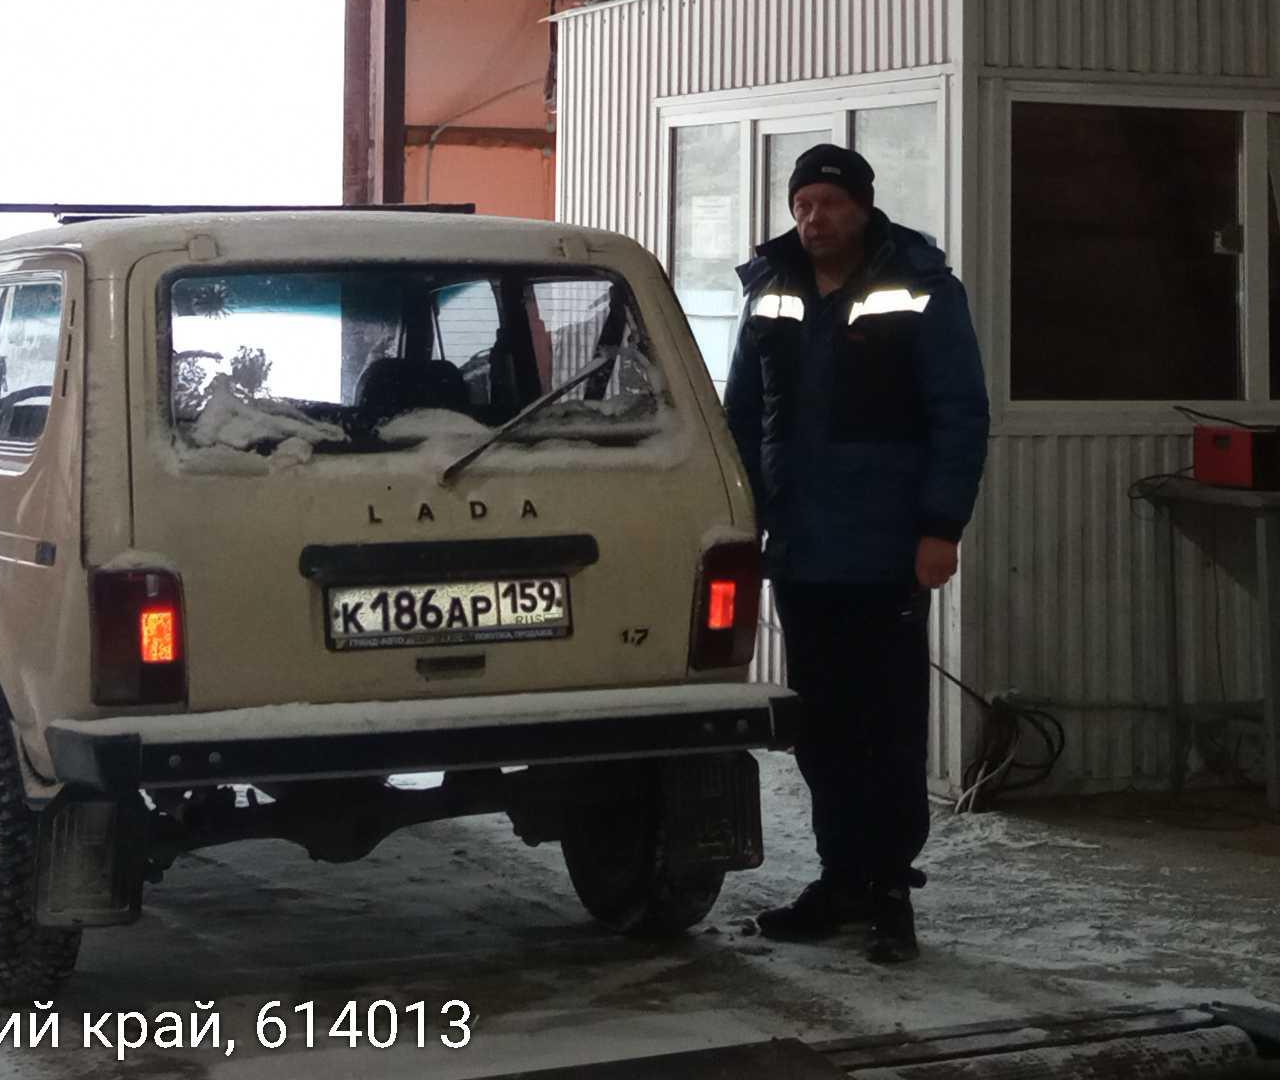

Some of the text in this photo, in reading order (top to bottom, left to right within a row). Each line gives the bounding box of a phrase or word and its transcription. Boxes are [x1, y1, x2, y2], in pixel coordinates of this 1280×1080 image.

[368, 499, 538, 524] LADA
[341, 580, 556, 633] К186АР 159
[621, 628, 649, 647] 1.7
